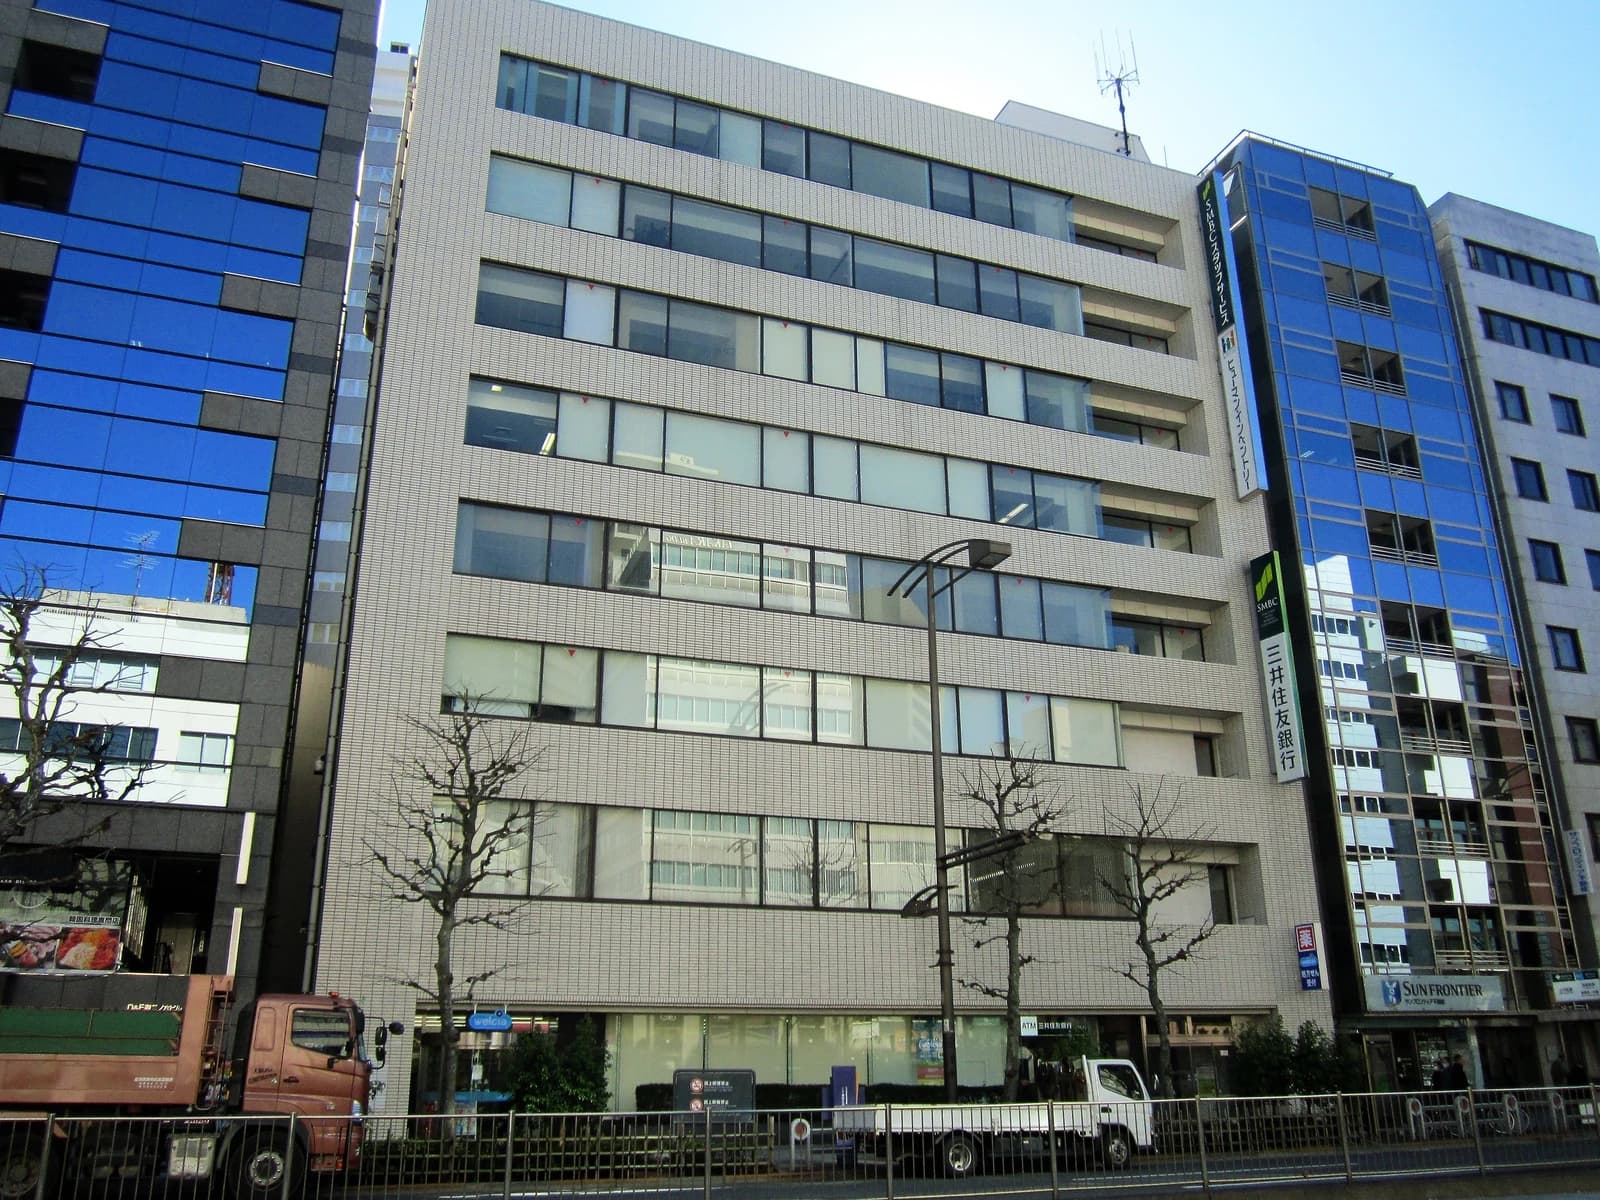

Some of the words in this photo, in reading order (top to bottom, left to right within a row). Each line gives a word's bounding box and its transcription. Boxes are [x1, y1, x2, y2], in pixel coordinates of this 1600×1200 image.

[1205, 198, 1229, 326] SMBCスタッフサービス
[1256, 596, 1279, 613] SMBC
[1265, 643, 1297, 772] 三井住友銀行
[1402, 981, 1427, 997] SUN
[1429, 983, 1483, 997] FRONTIER
[1022, 1022, 1037, 1030] ATM
